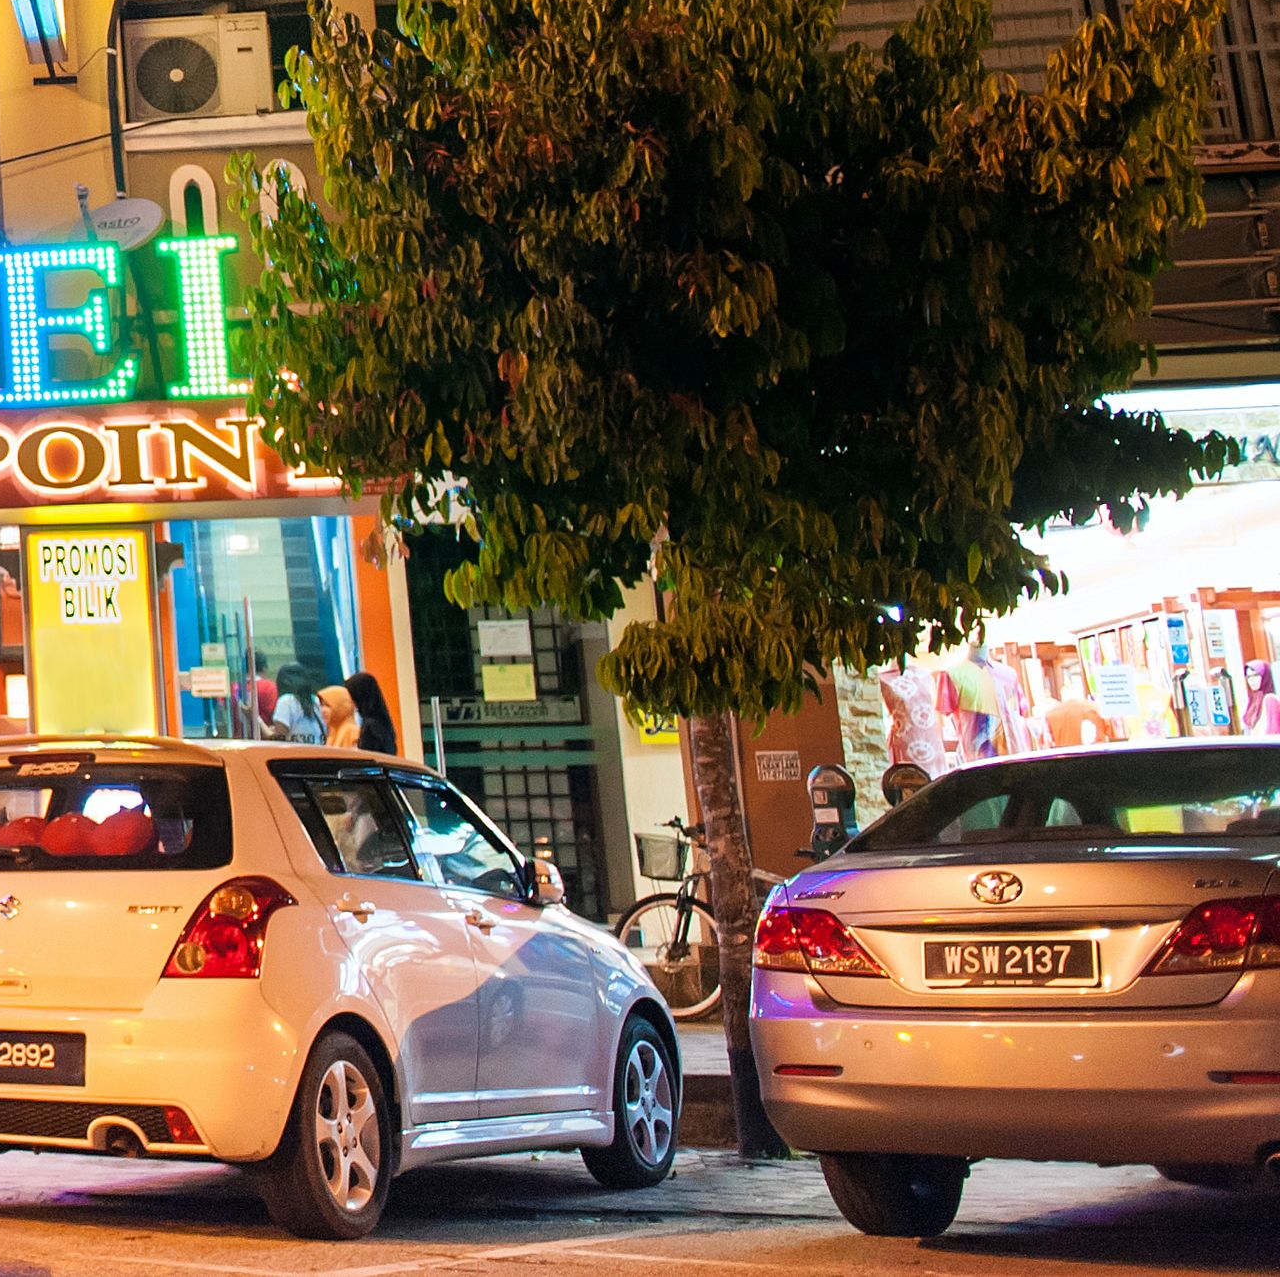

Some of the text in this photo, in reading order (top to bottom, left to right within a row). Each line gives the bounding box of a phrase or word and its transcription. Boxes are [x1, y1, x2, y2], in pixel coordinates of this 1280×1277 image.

[97, 216, 141, 230] astro
[42, 543, 135, 576] PROMOSI
[64, 586, 118, 618] BILIK
[944, 945, 1072, 974] WSW 2137
